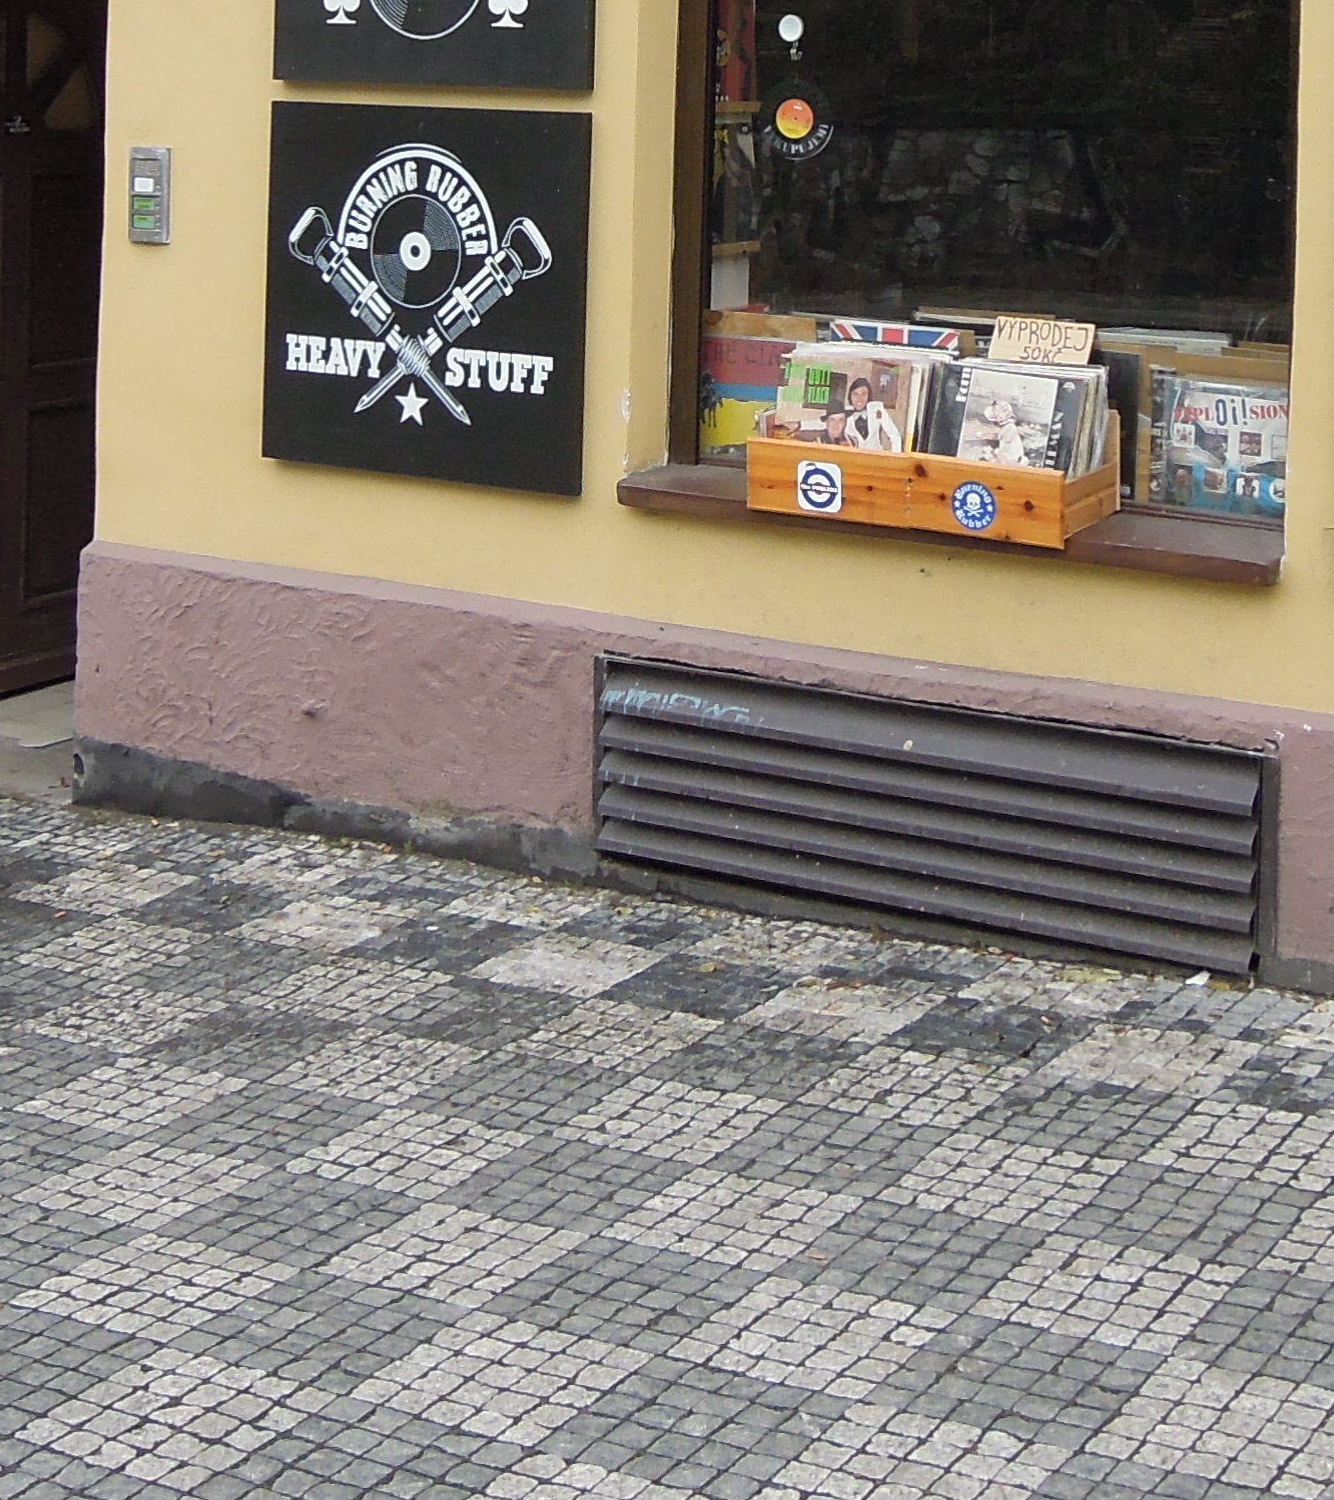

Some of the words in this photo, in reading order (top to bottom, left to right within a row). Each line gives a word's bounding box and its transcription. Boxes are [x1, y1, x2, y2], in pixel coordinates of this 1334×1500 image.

[345, 161, 418, 250] BURNING
[426, 164, 489, 256] RUBBER
[286, 333, 386, 378] HEAVY
[445, 347, 553, 395] STUFF
